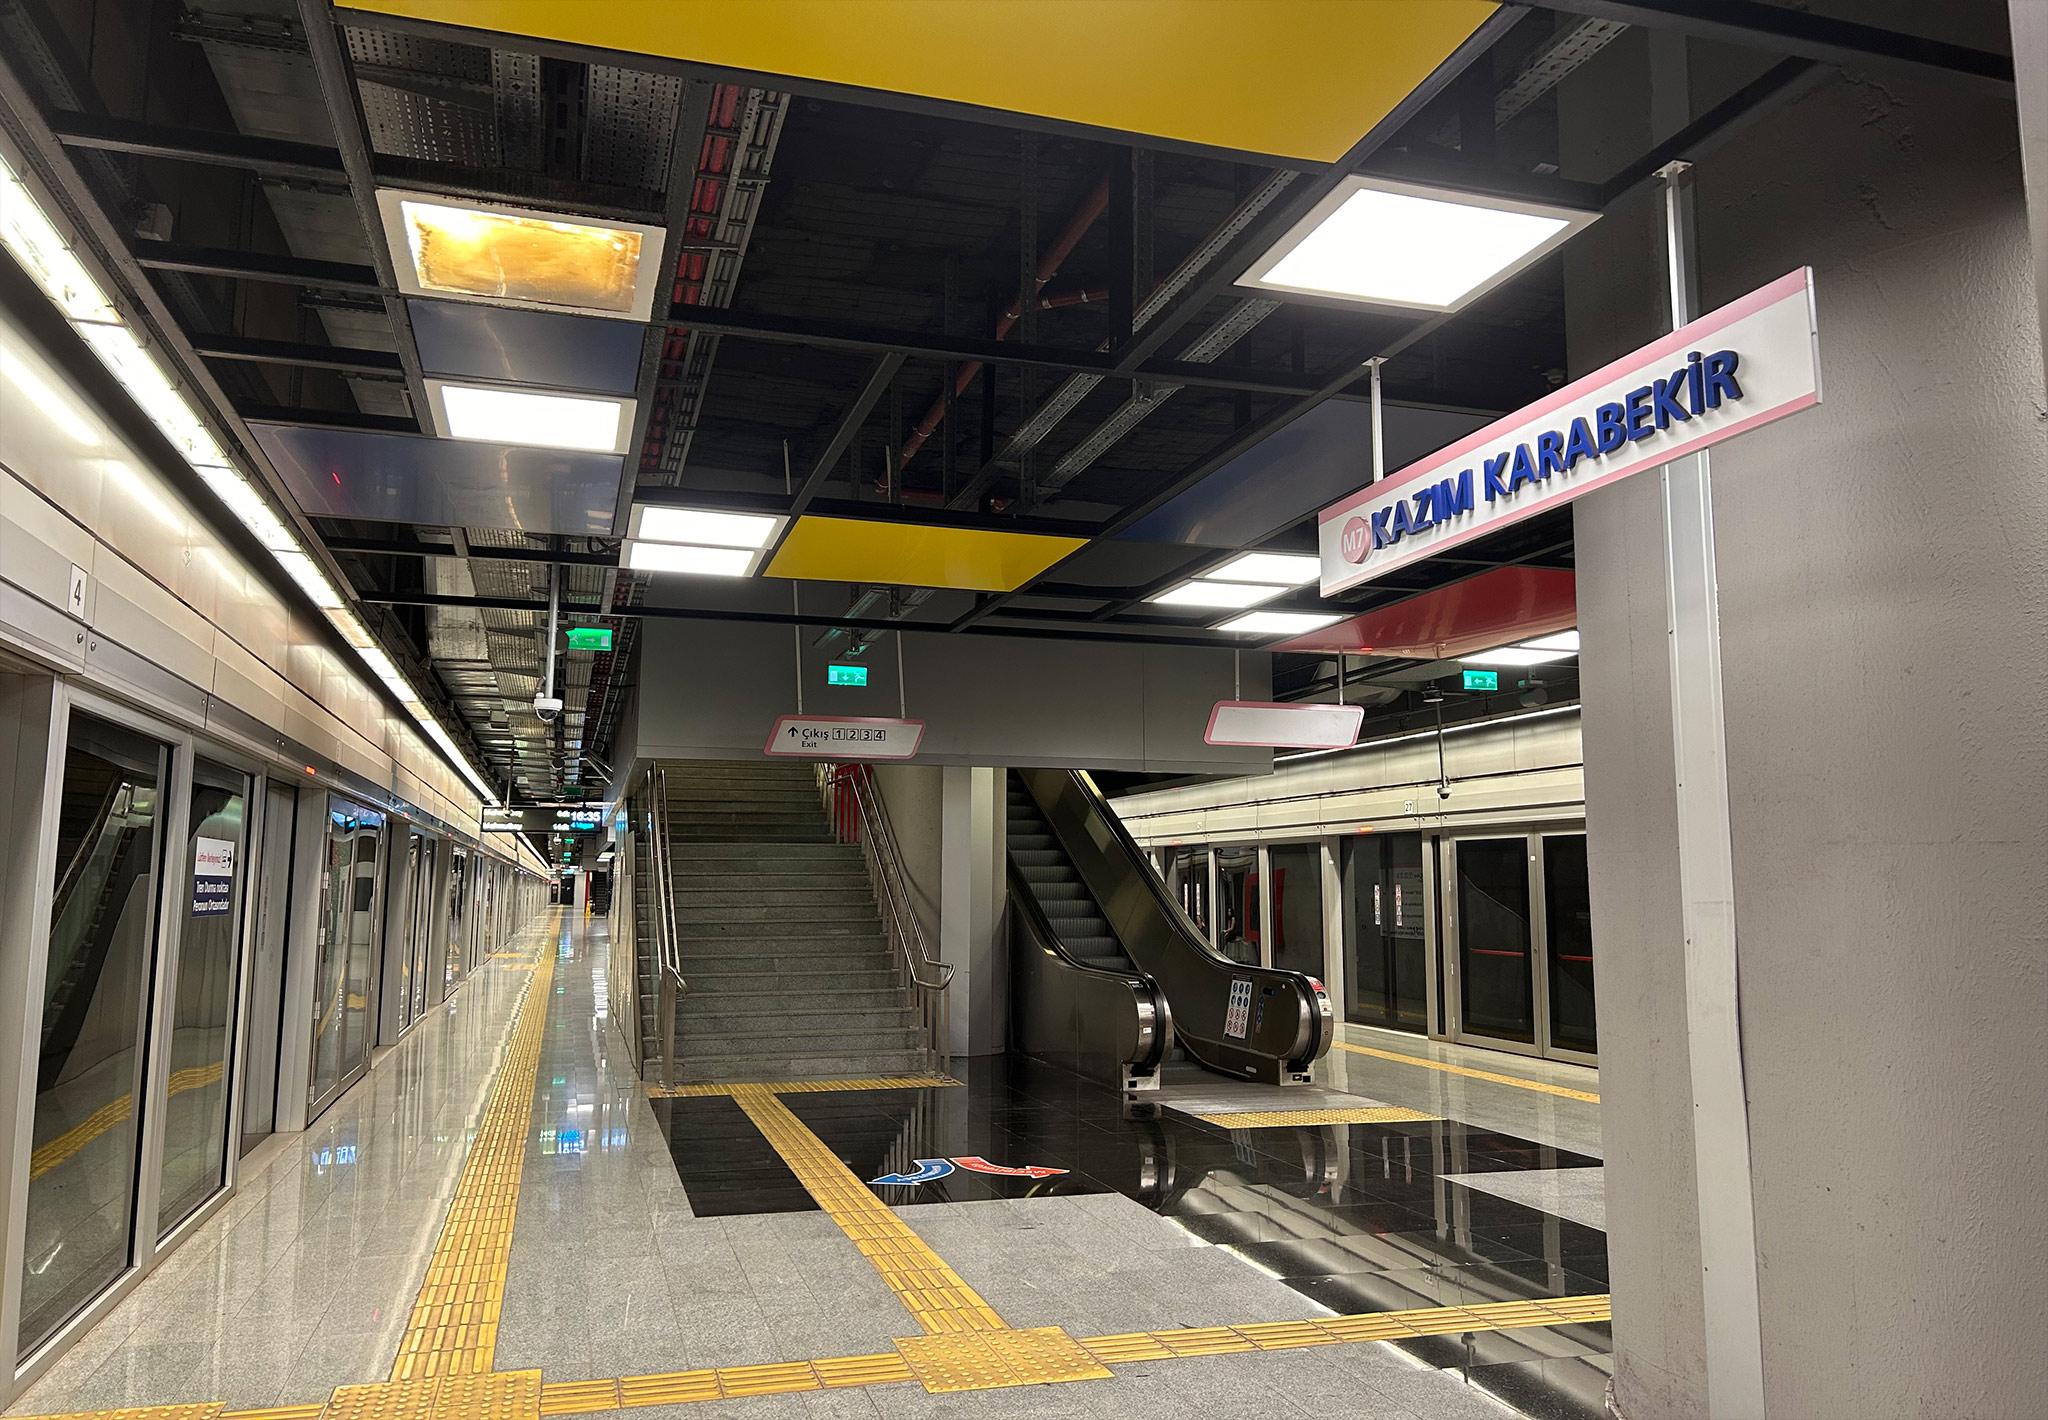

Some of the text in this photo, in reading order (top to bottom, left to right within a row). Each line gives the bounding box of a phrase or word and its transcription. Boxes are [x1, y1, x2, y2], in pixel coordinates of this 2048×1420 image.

[1343, 350, 1744, 554] M7 KAZIM KARABEKİR
[73, 578, 82, 607] 4
[801, 728, 830, 741] Çıkış
[801, 740, 817, 748] Exit
